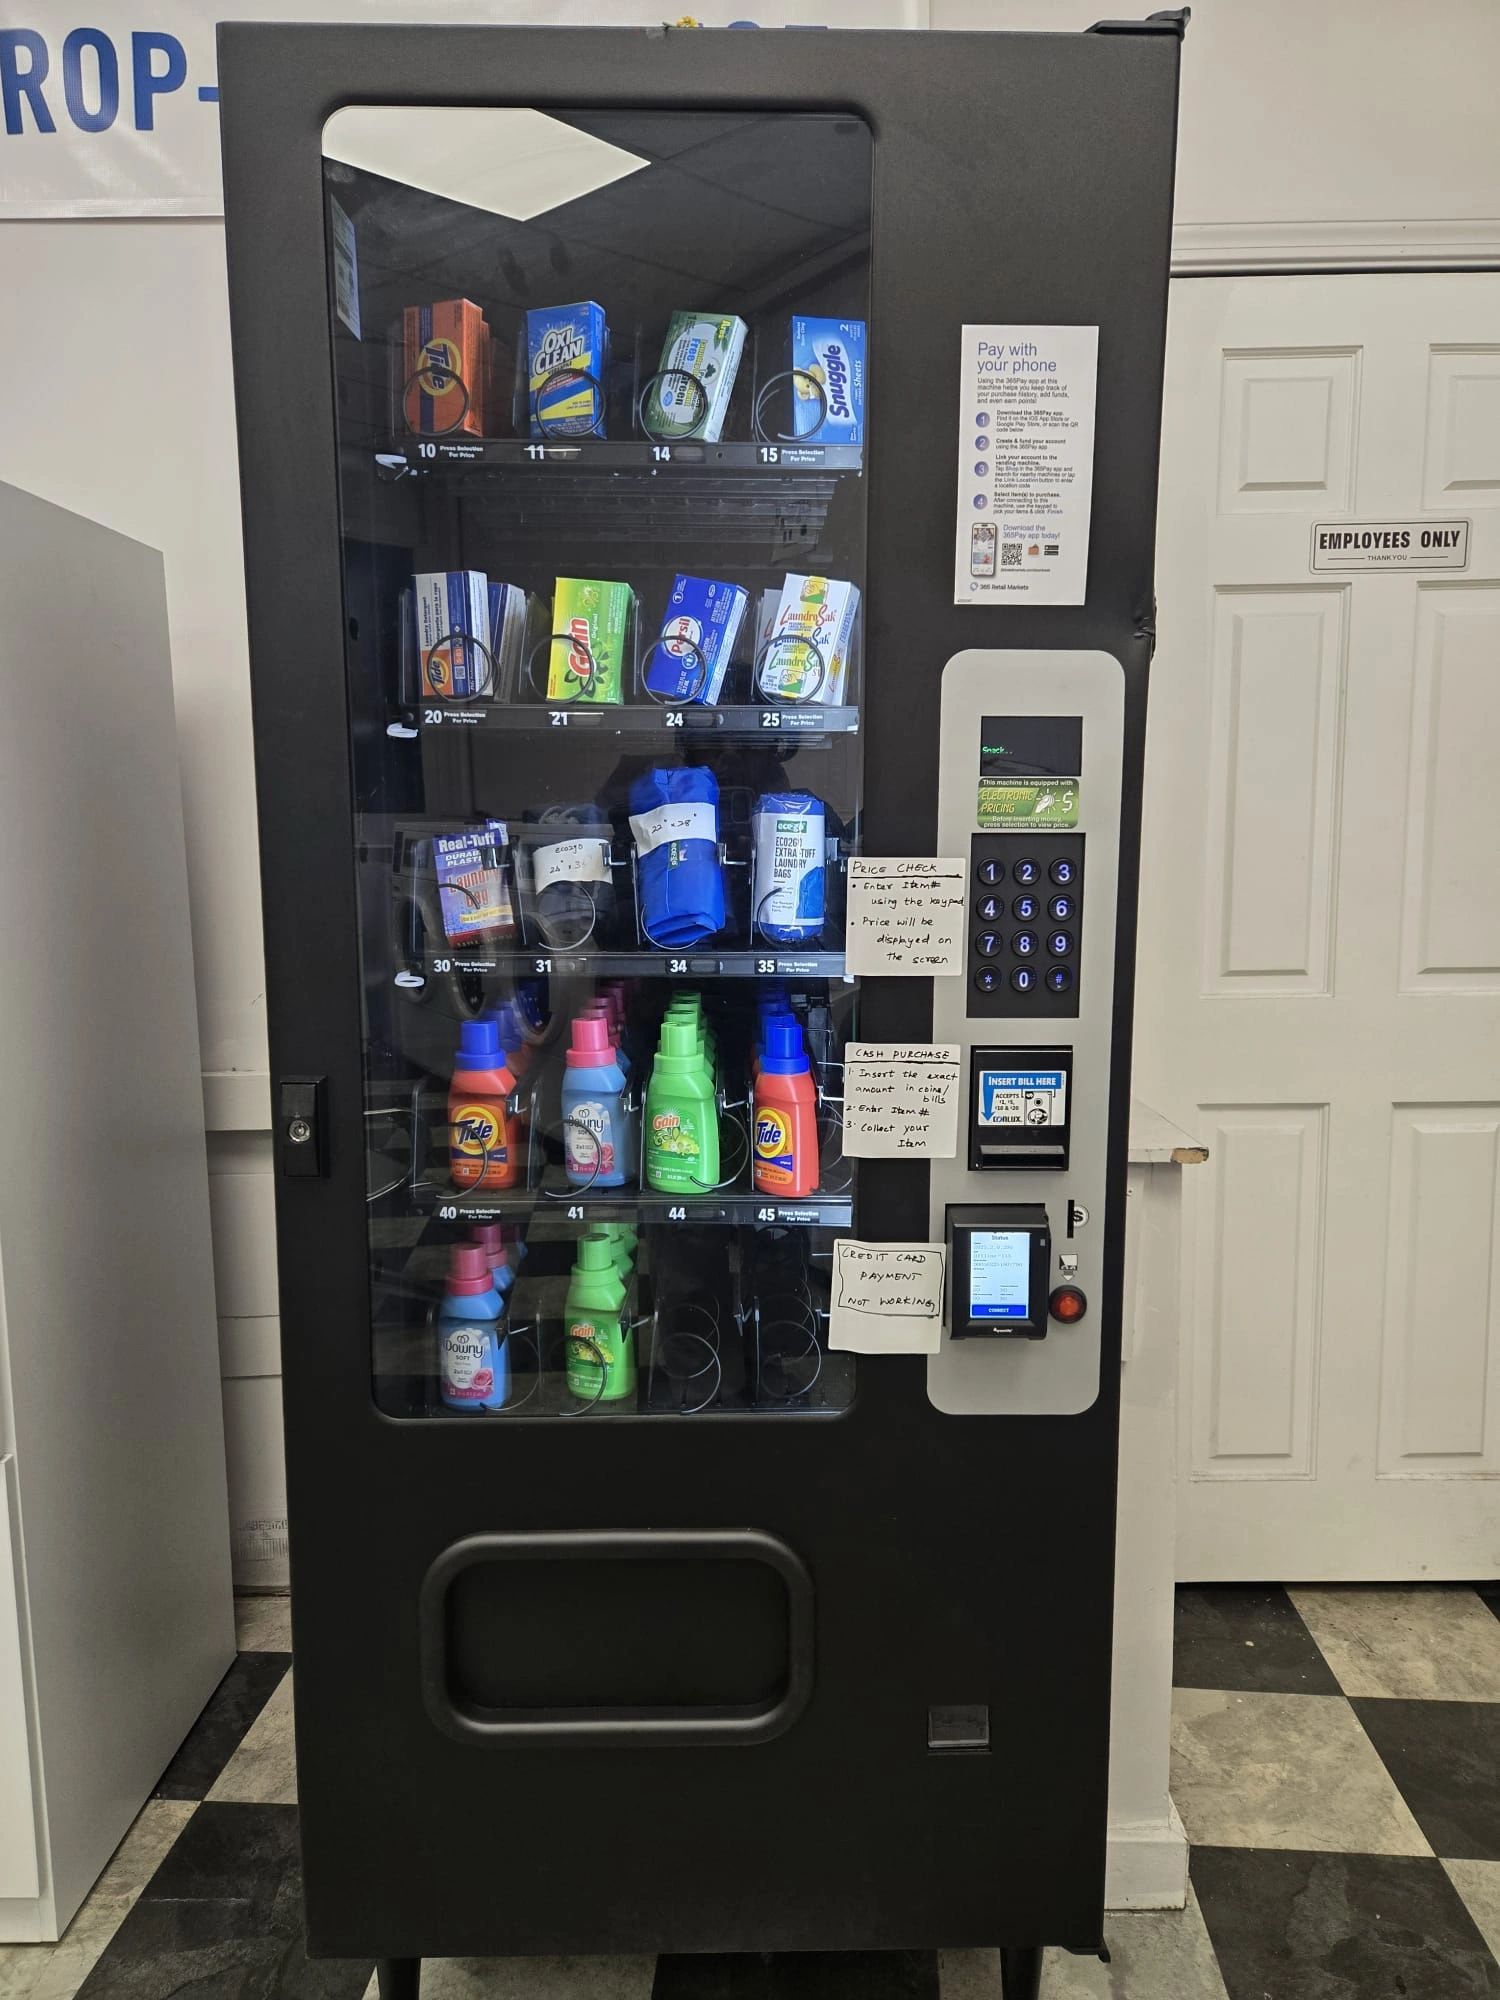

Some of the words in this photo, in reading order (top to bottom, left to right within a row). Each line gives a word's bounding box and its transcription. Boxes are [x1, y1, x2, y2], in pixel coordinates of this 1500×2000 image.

[544, 328, 572, 353] OXI
[535, 339, 583, 375] CLEAN
[687, 338, 701, 362] Free
[978, 342, 1005, 359] Pay
[1009, 342, 1037, 356] with
[977, 360, 1008, 374] your
[1012, 358, 1057, 374] phone
[854, 360, 862, 387] Sheets
[823, 345, 850, 418] Snuggle
[418, 444, 436, 458] 10
[528, 445, 544, 459] 11
[653, 447, 670, 461] 14
[761, 448, 778, 462] 15
[1319, 531, 1410, 549] EMPLOYEES
[1421, 531, 1461, 548] ONLY
[780, 604, 836, 626] LaundroSak
[671, 618, 690, 654] Persil
[568, 617, 596, 676] Gain
[430, 661, 445, 684] Tide
[425, 710, 442, 724] 20
[552, 712, 568, 725] 21
[666, 713, 684, 726] 24
[763, 713, 780, 726] 25
[981, 791, 1033, 800] ELECTRONIC
[981, 804, 1015, 813] PRICING
[439, 831, 495, 853] Real-Tuff
[775, 859, 807, 869] LAUNDRY
[852, 860, 887, 874] PRICE
[897, 863, 937, 873] CHECK
[774, 869, 792, 878] BAGS
[986, 864, 995, 880] 1
[1022, 865, 1032, 880] 2
[1058, 865, 1070, 881] 3
[863, 882, 893, 890] Enter
[871, 897, 897, 910] using
[904, 898, 923, 907] the
[930, 897, 965, 907] keypad
[985, 900, 995, 916] 4
[1021, 900, 1032, 917] 5
[1056, 900, 1068, 916] 6
[862, 916, 890, 926] Price
[897, 917, 916, 927] will
[921, 917, 934, 926] be
[877, 934, 930, 948] displayed
[985, 936, 994, 952] 7
[1020, 936, 1030, 952] 8
[1055, 936, 1066, 952] 9
[434, 960, 450, 972] 30
[536, 960, 552, 972] 31
[670, 960, 687, 973] 34
[758, 960, 775, 973] 35
[912, 956, 948, 964] screen
[1019, 972, 1029, 988] 0
[855, 1048, 884, 1058] CASH
[893, 1050, 950, 1059] PURCHASE
[859, 1069, 895, 1079] Insert
[903, 1070, 918, 1078] the
[927, 1072, 958, 1080] exact
[988, 1076, 1016, 1086] INSERT
[1018, 1077, 1035, 1086] BILL
[1036, 1077, 1056, 1086] HERE
[855, 1086, 895, 1094] amount
[923, 1095, 946, 1104] bills
[891, 1106, 916, 1115] Item
[653, 1115, 680, 1130] Gain
[861, 1123, 895, 1133] Collect
[903, 1124, 930, 1135] your
[458, 1119, 493, 1145] Tide
[757, 1122, 781, 1145] Tide
[897, 1139, 927, 1147] Item
[440, 1207, 457, 1219] 40
[568, 1207, 584, 1219] 41
[669, 1208, 686, 1220] 44
[758, 1209, 775, 1221] 45
[842, 1247, 888, 1261] CREDIT
[897, 1254, 926, 1263] CARD
[860, 1271, 922, 1282] PAYMENT
[848, 1298, 870, 1306] NOT
[880, 1296, 936, 1312] WORKING
[445, 1340, 484, 1358] Downy
